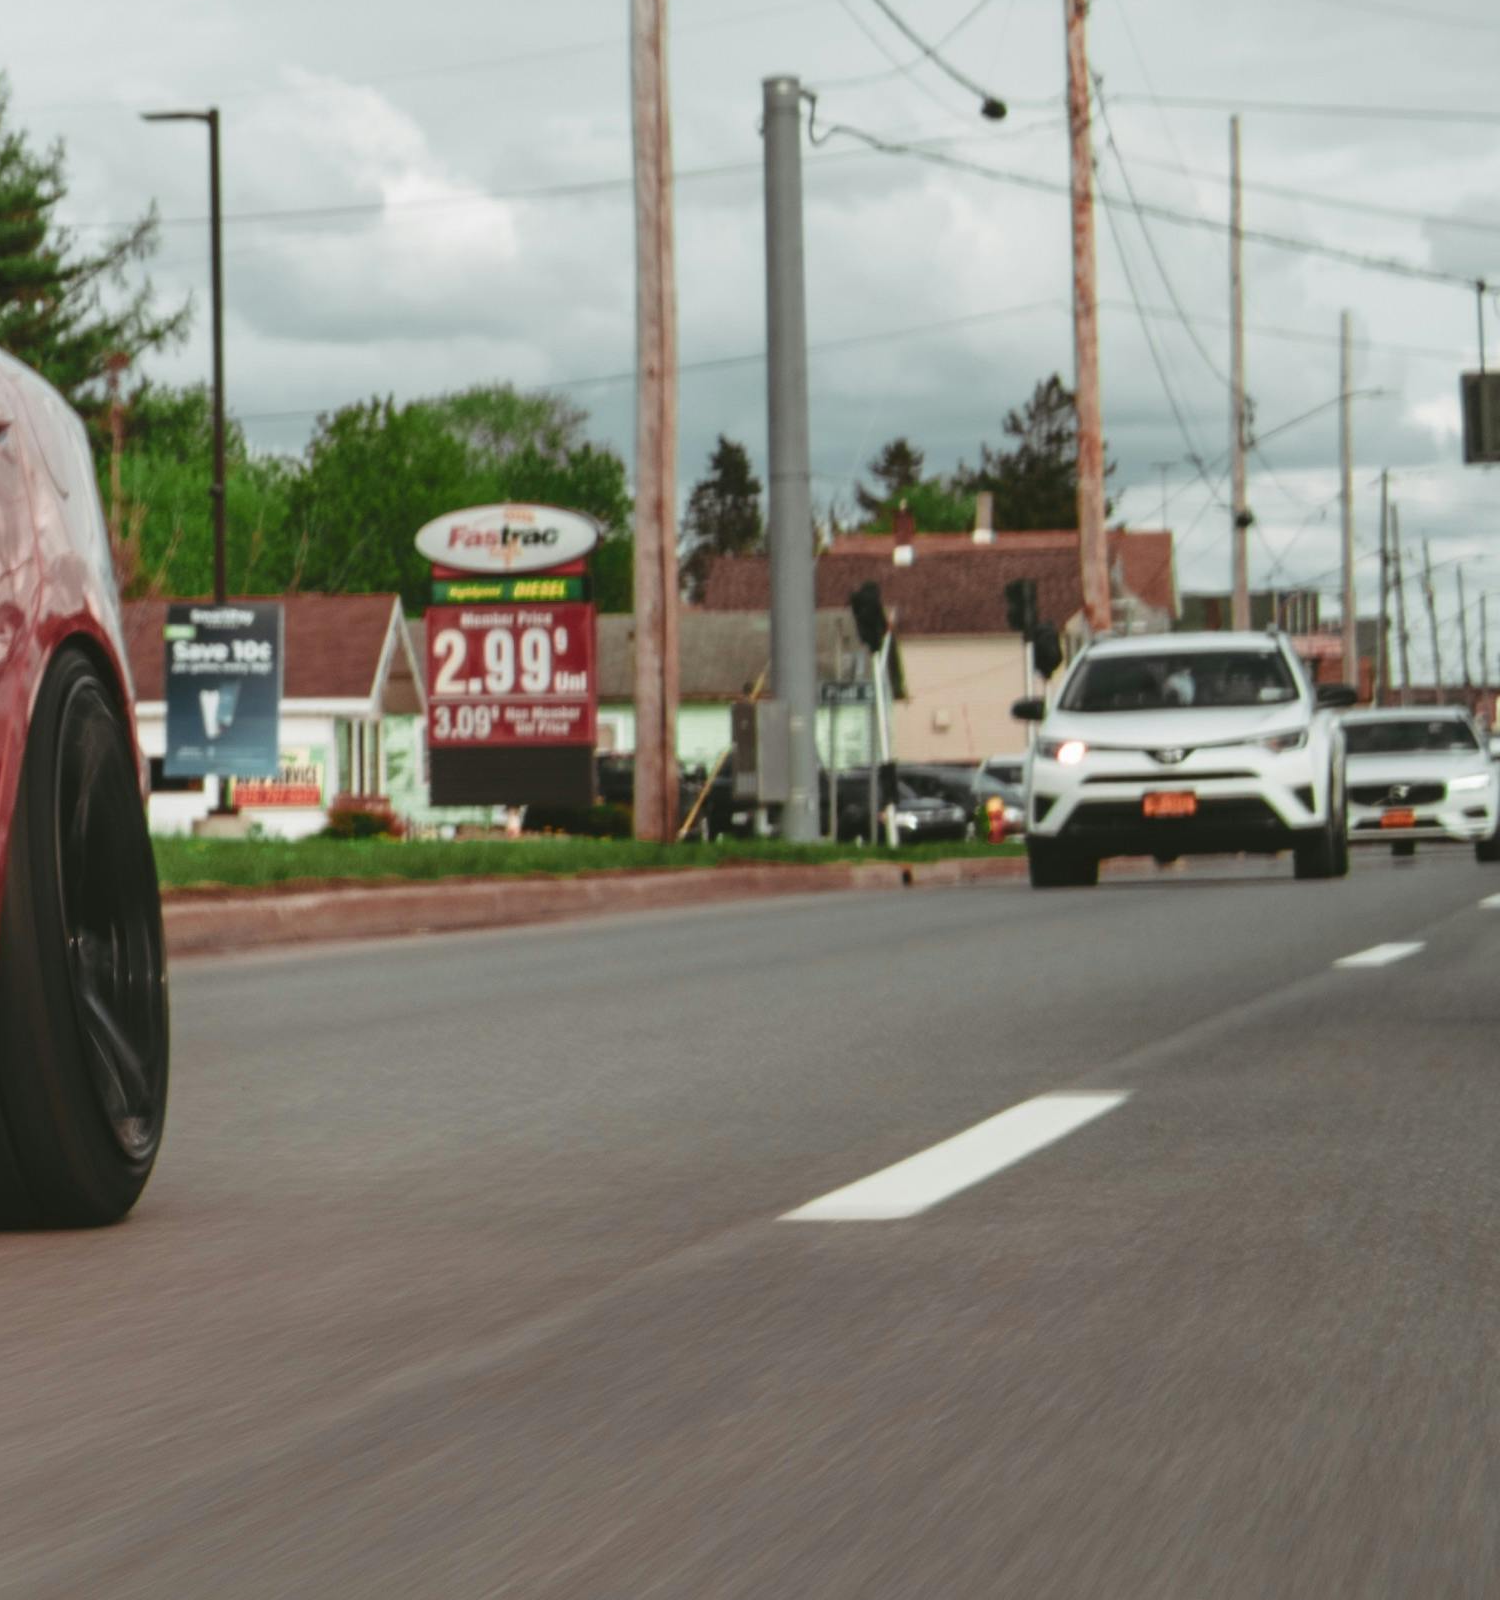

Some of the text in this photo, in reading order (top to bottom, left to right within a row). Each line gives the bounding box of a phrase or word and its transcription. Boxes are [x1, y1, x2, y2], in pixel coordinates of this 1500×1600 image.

[448, 524, 559, 549] Fastrac
[514, 580, 566, 600] DIESEL
[460, 610, 553, 628] Member Price
[173, 639, 229, 662] Save
